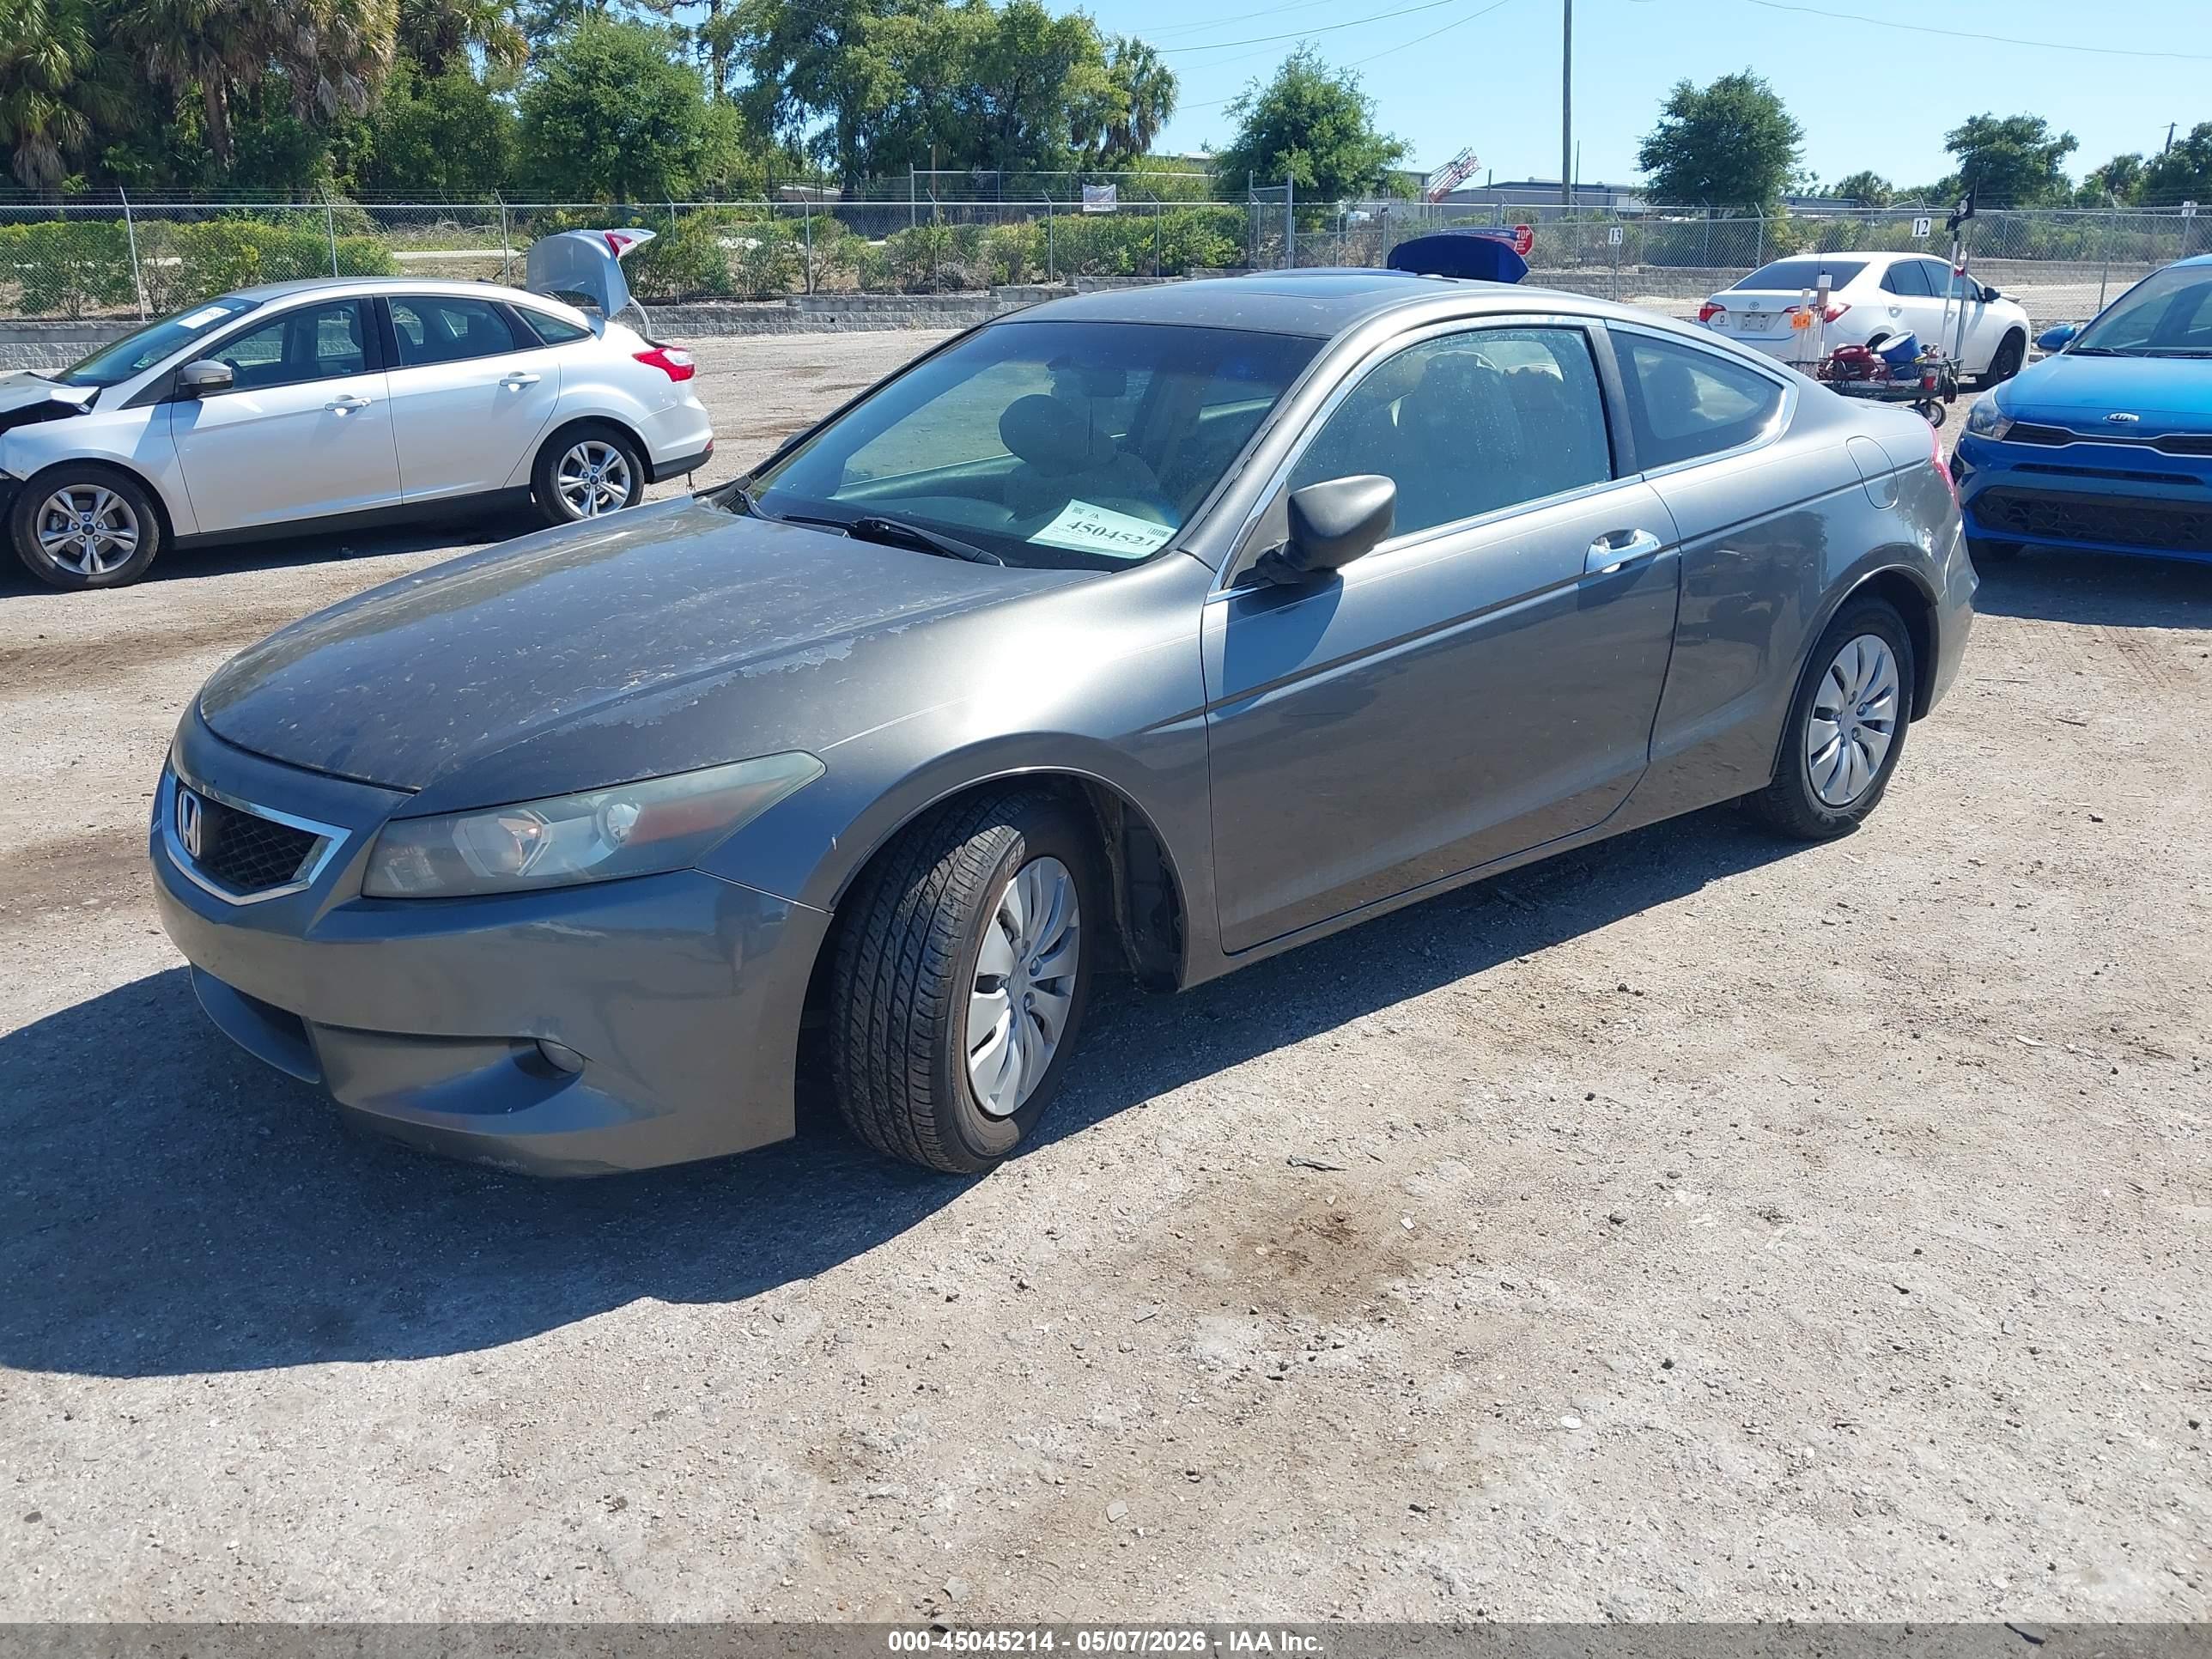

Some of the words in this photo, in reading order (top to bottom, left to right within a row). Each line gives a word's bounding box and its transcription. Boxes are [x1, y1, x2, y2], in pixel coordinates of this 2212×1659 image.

[1916, 219, 1929, 235] 12
[1516, 229, 1531, 240] TOP
[1611, 229, 1621, 242] 13
[2109, 412, 2139, 422] KIA
[1066, 520, 1163, 547] 4504521
